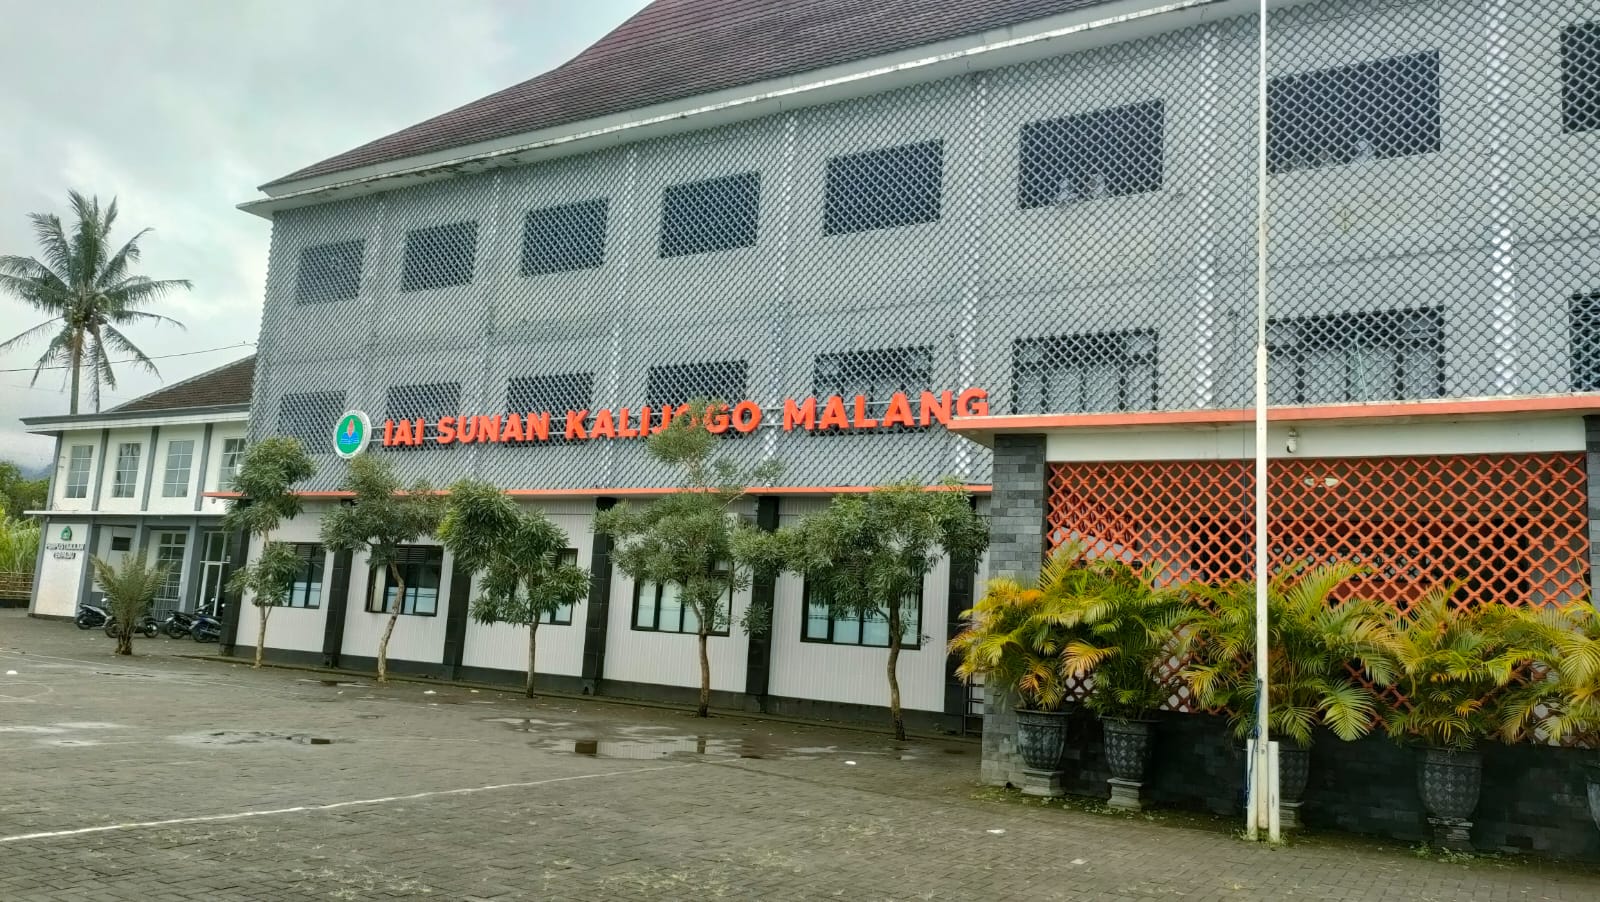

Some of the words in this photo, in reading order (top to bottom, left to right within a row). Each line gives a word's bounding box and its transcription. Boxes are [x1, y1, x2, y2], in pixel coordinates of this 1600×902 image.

[383, 418, 425, 447] IAI
[437, 412, 550, 444] SUNAN
[783, 387, 989, 432] MALANG
